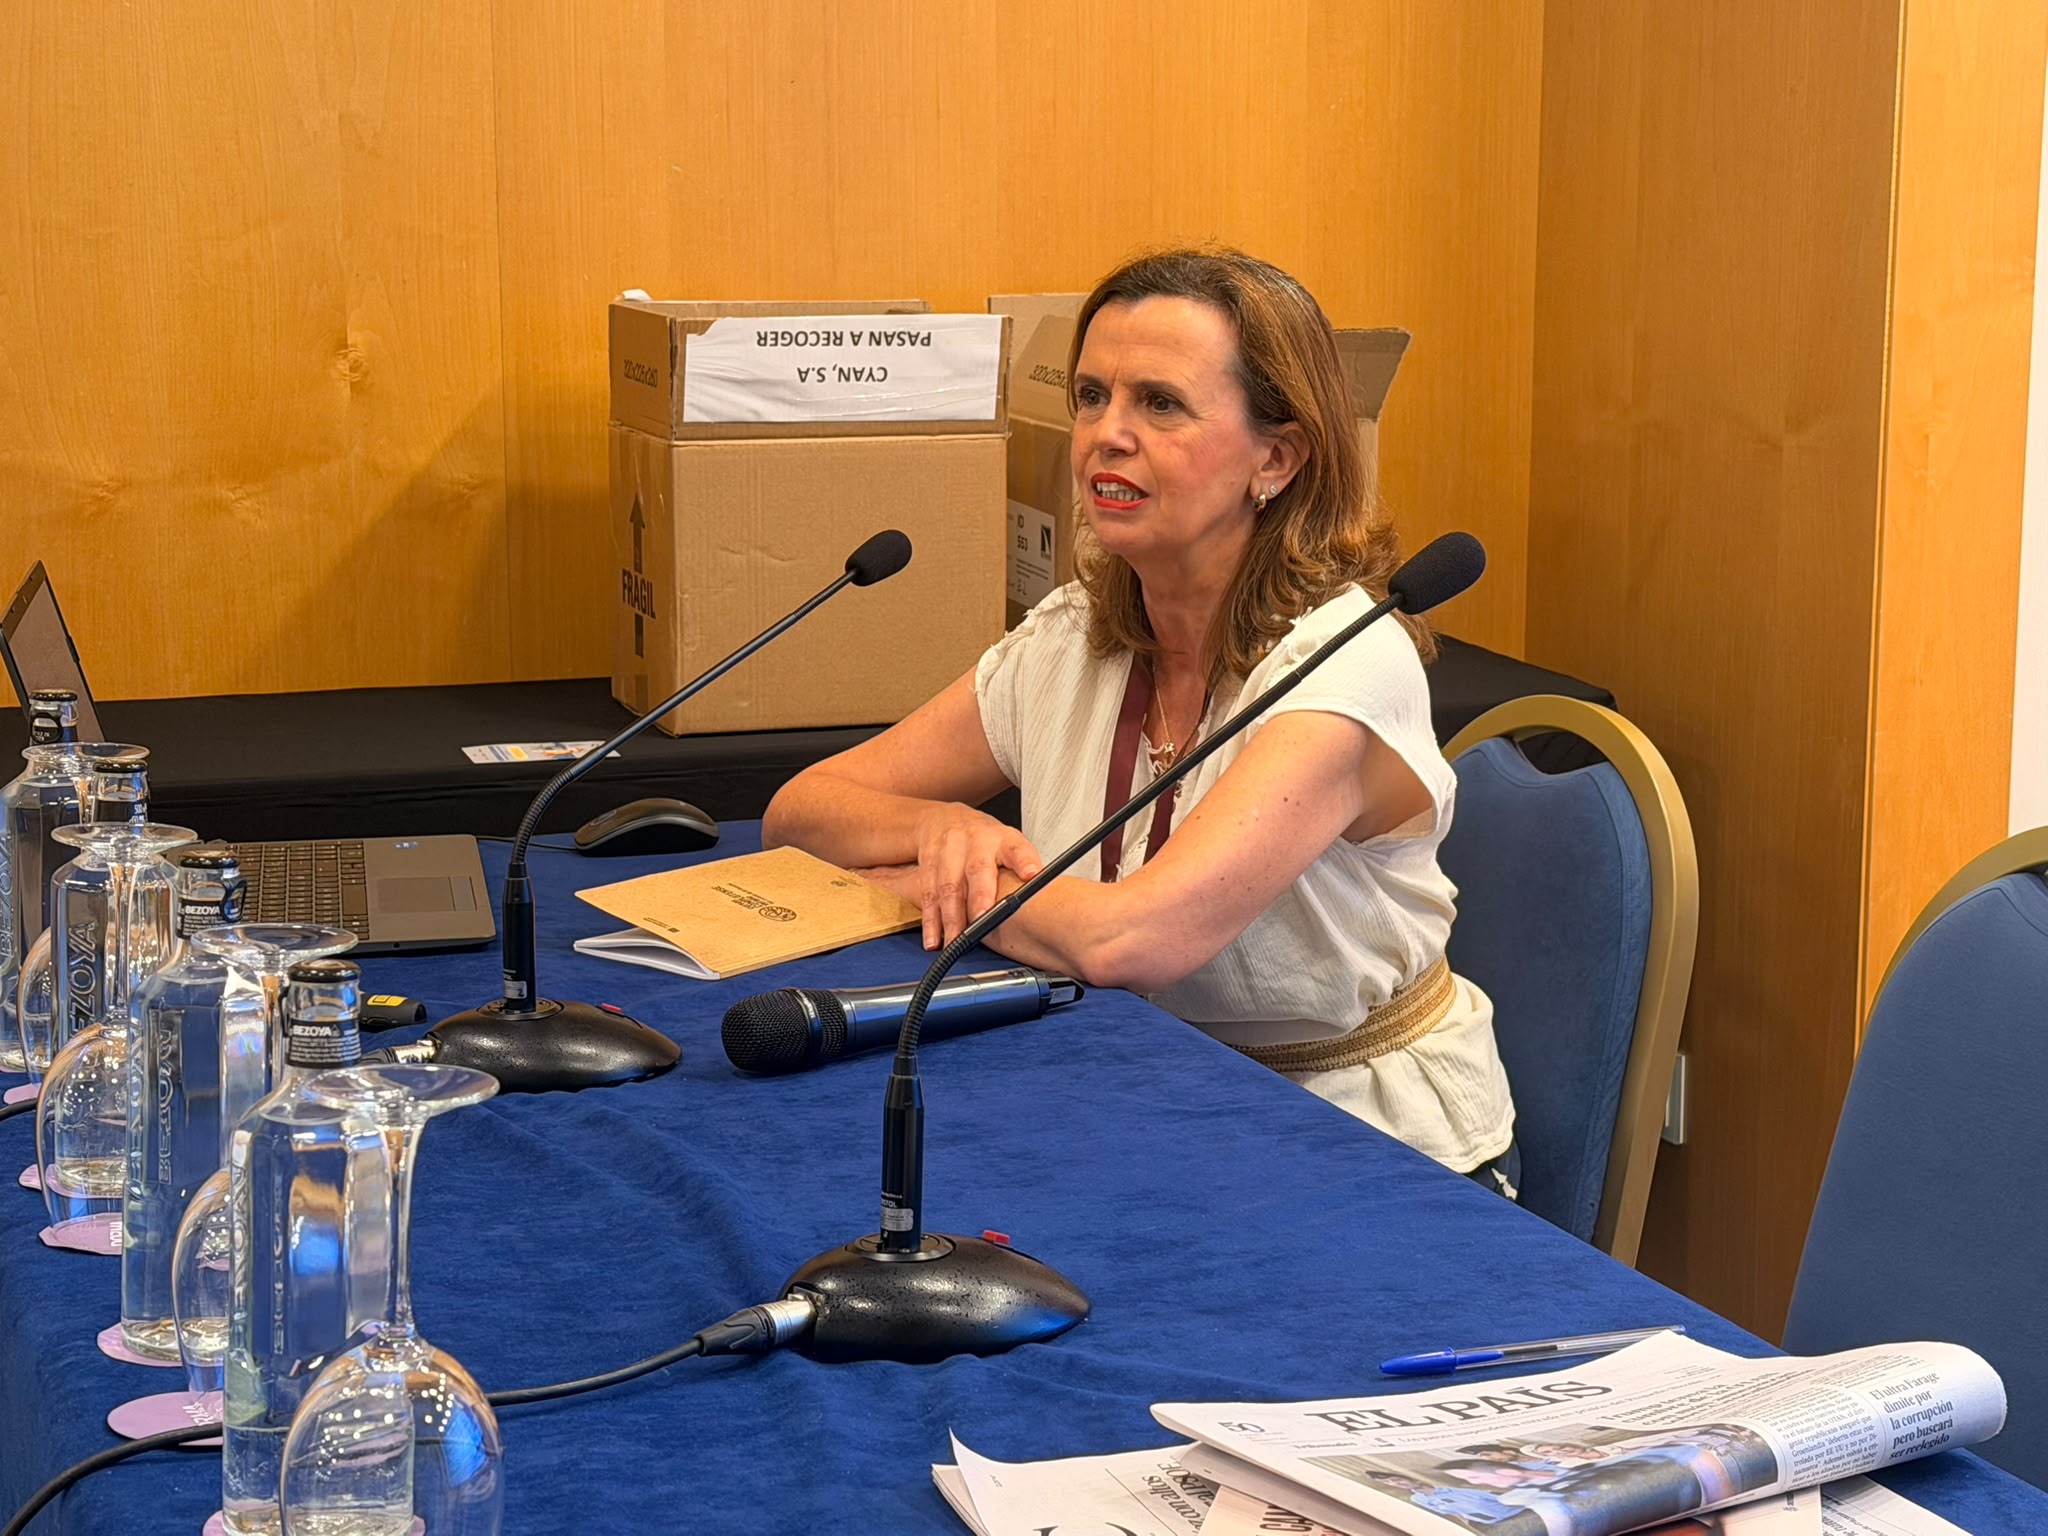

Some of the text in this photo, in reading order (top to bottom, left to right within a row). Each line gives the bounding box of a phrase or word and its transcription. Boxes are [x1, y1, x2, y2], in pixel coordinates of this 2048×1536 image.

[756, 331, 932, 347] PASAN A RECOGER
[797, 364, 889, 383] CYAN, S.A
[185, 904, 220, 915] BEZOYA
[293, 1024, 333, 1037] BEZOYA
[1869, 1372, 1940, 1401] El ultra Farage
[1303, 1408, 1446, 1433] EL
[1418, 1380, 1613, 1421] PAÍS
[1883, 1390, 1933, 1414] dimite por
[1889, 1400, 1954, 1431] la corrupción
[1892, 1415, 1954, 1450] pero buscará
[1905, 1432, 1950, 1455] reelegido
